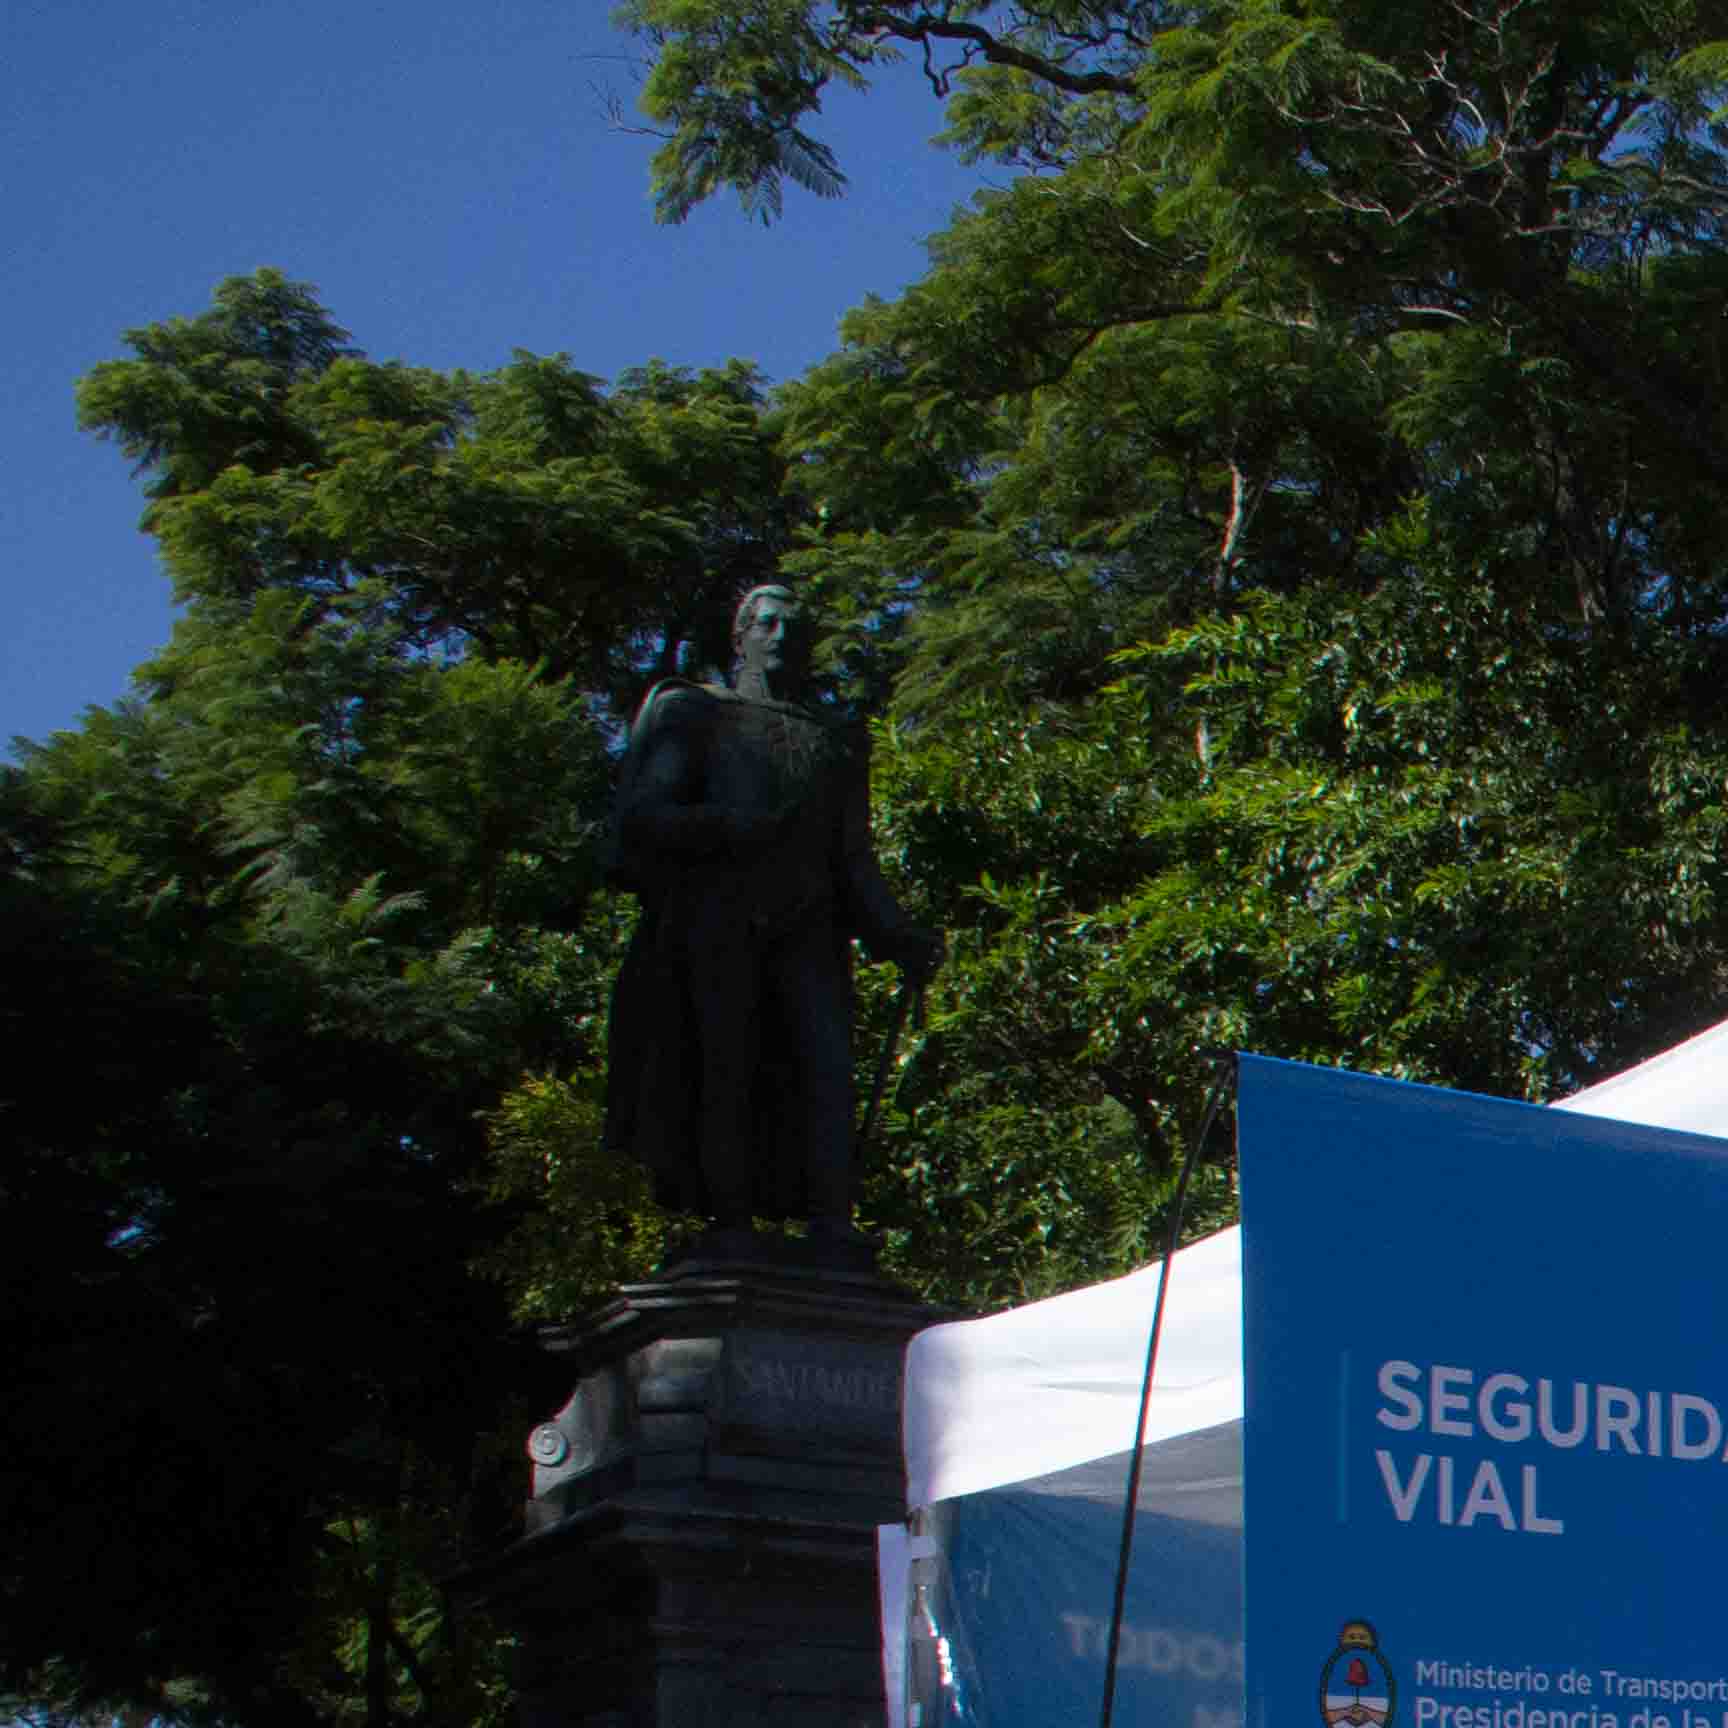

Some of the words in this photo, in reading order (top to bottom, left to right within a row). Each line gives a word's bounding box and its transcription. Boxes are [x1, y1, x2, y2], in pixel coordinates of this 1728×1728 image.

[1375, 1449, 1565, 1535] VIAL
[1414, 1660, 1550, 1694] Ministerio
[1557, 1668, 1593, 1695] de
